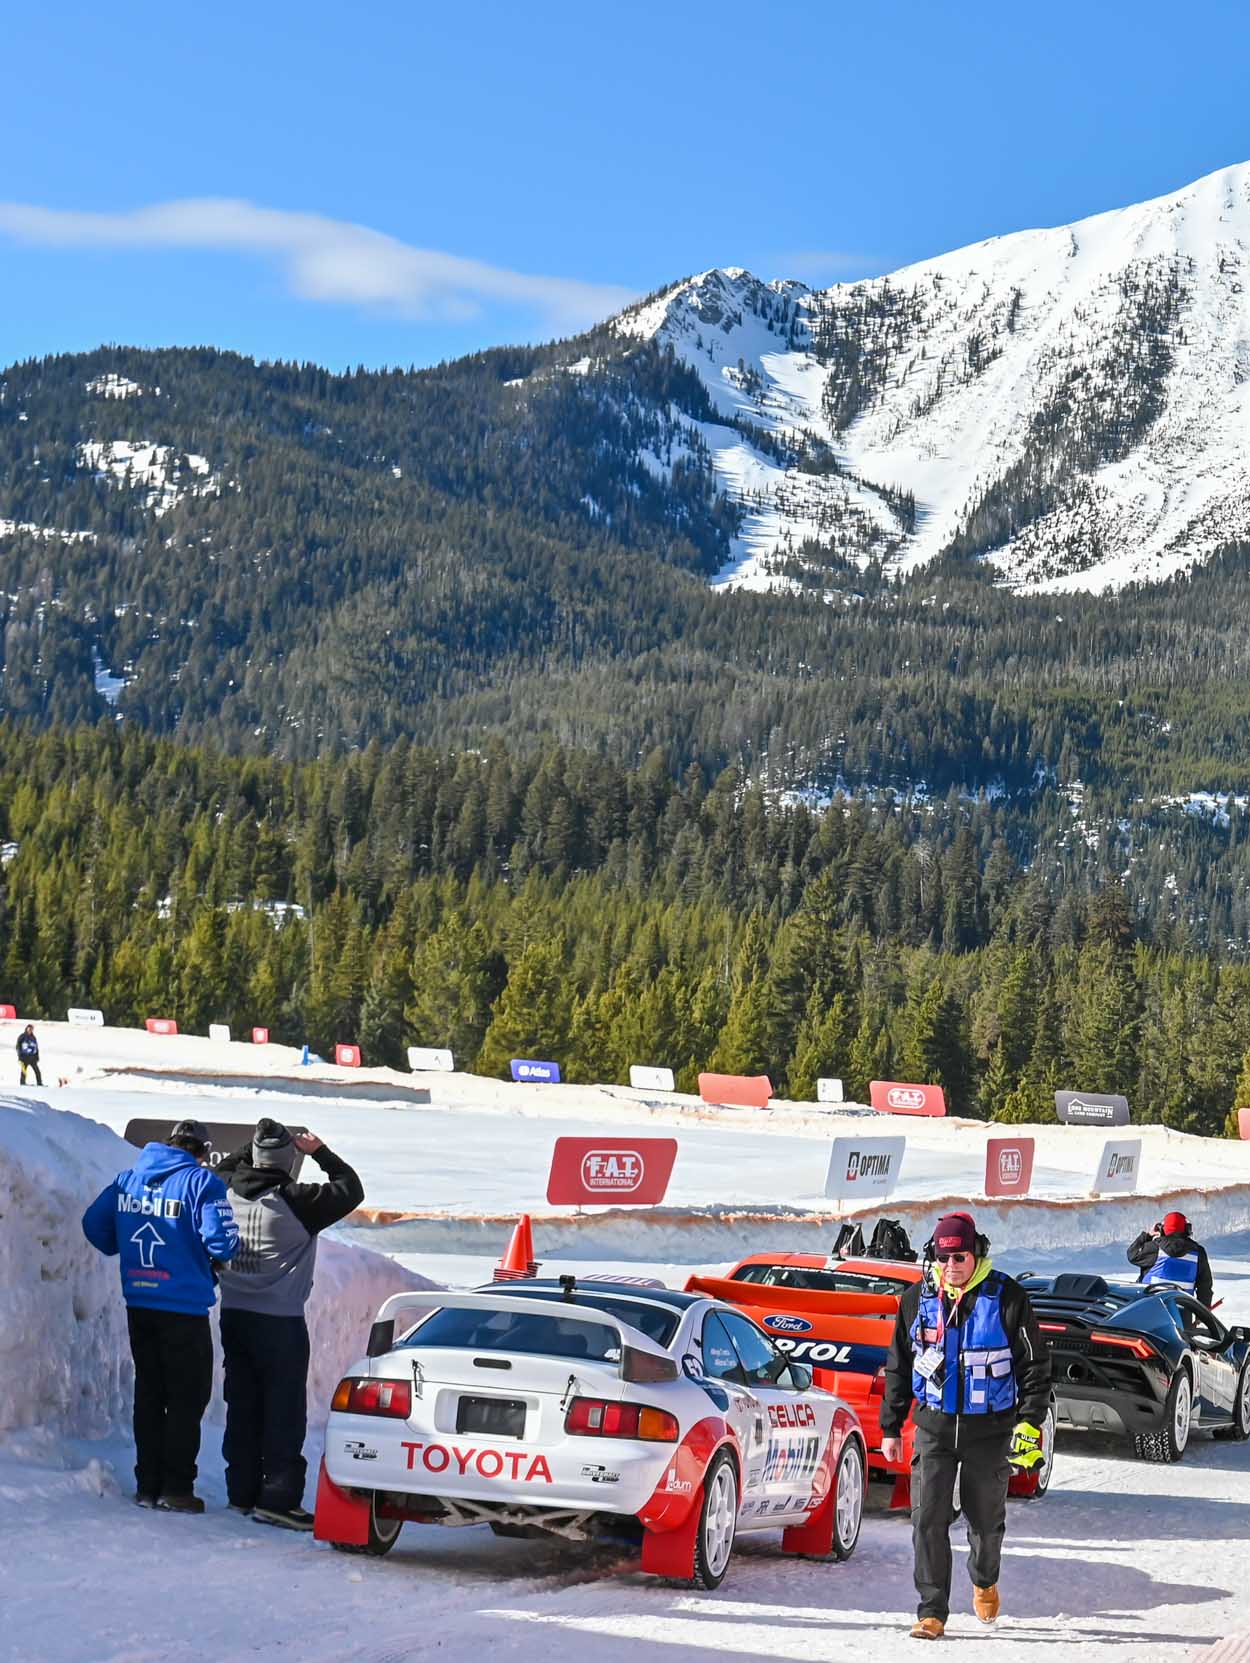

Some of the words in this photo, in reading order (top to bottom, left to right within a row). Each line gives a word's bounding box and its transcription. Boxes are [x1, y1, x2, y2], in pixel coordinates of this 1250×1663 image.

[860, 1154, 891, 1177] OPTIMA
[589, 1178, 635, 1186] INTERNATIONAL
[117, 1192, 162, 1217] Mobil
[771, 1315, 804, 1331] Ford
[771, 1337, 852, 1364] PSOL
[767, 1403, 816, 1429] CELICA
[401, 1441, 552, 1484] TOYOTA
